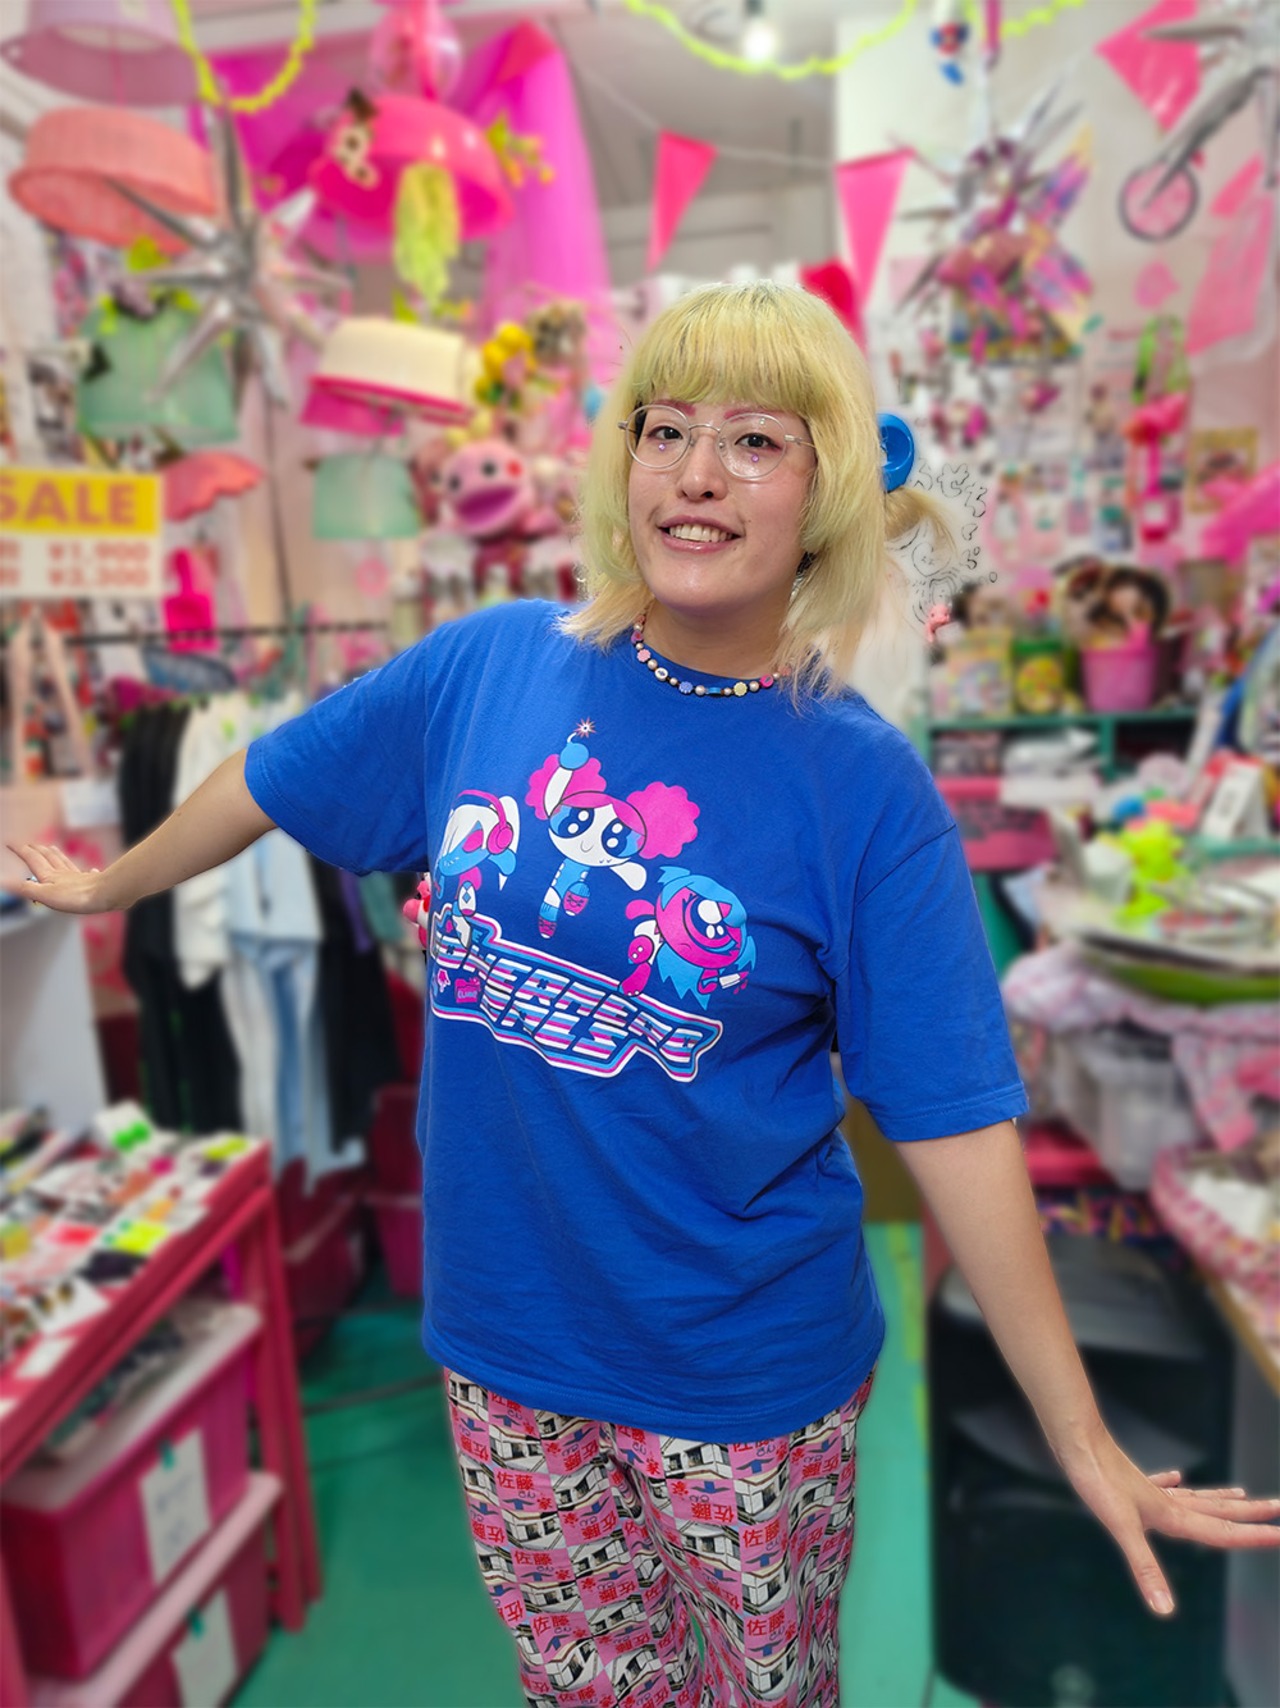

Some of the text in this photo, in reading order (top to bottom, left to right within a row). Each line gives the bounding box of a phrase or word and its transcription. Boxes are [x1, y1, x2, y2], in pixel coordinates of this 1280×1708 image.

[497, 1471, 535, 1490] 佐藤
[691, 1502, 734, 1523] 佐藤
[743, 1519, 779, 1548] 佐藤
[514, 1551, 552, 1566] 佐藤
[533, 1615, 569, 1636] 佐藤
[747, 1608, 785, 1636] 佐藤
